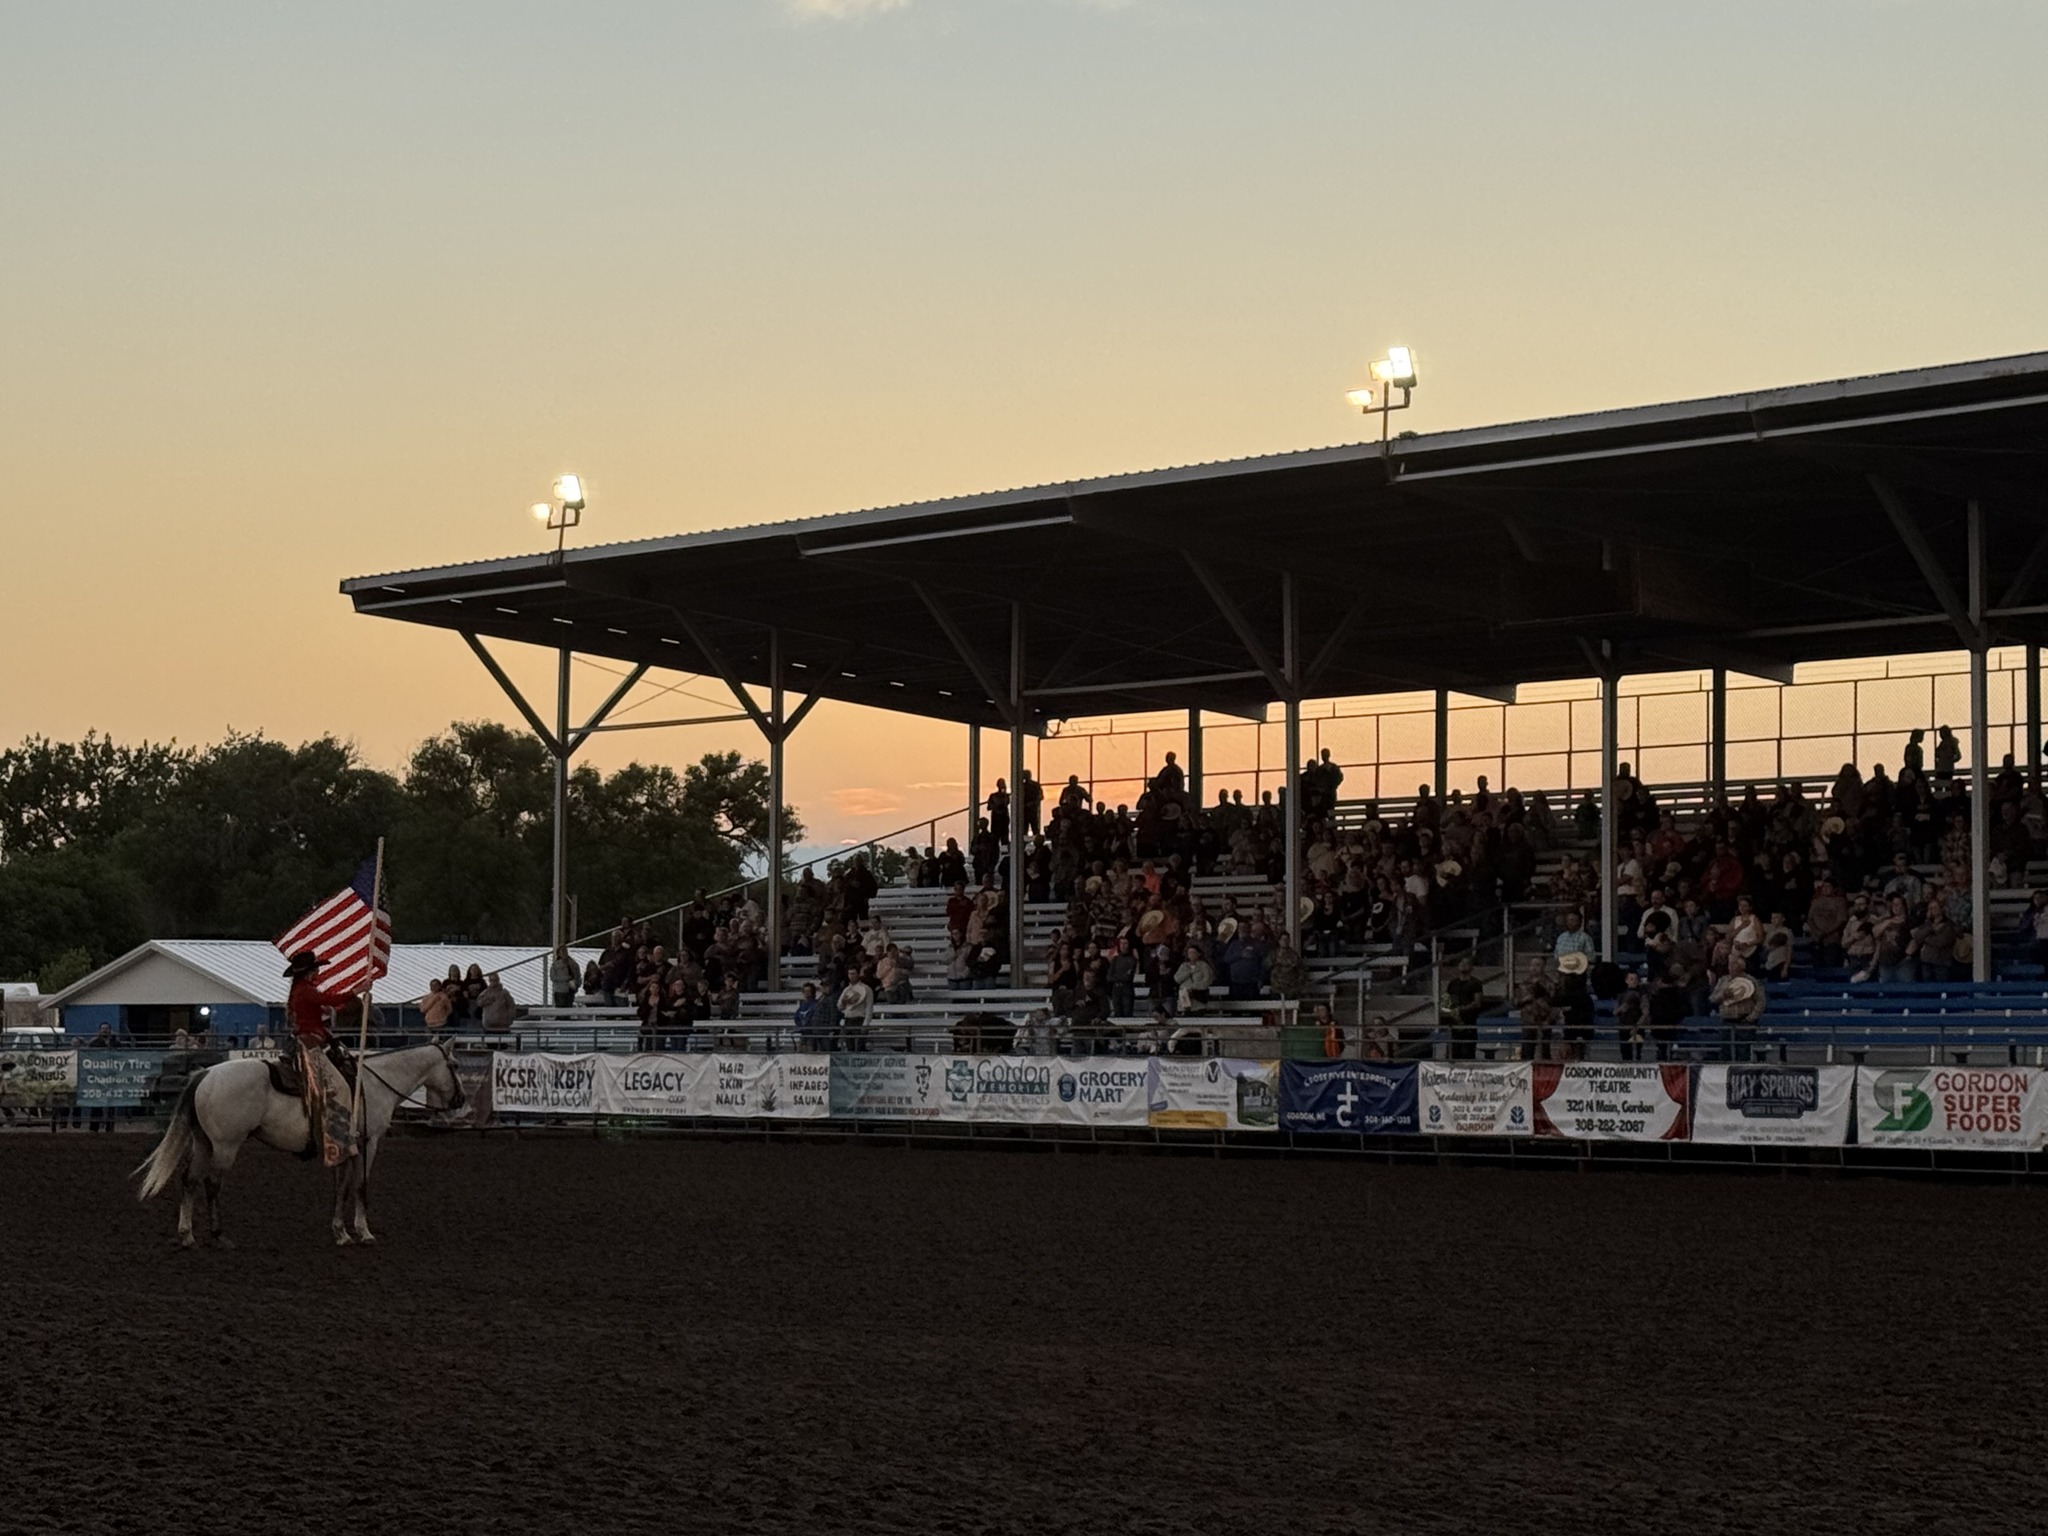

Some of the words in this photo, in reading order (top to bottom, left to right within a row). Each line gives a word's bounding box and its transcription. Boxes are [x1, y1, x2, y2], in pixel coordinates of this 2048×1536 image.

[242, 1051, 266, 1059] LAZY
[82, 1058, 124, 1071] Quality
[128, 1059, 152, 1069] Tire
[719, 1063, 744, 1075] HAIR
[789, 1066, 829, 1076] MASSAGE
[976, 1058, 1051, 1083] Gordon
[495, 1068, 537, 1089] KCSR
[554, 1069, 596, 1090] KBPY
[1079, 1071, 1149, 1087] GROCERY
[1564, 1066, 1603, 1079] GORDON
[1603, 1066, 1660, 1080] COMMUNITY
[624, 1071, 686, 1091] LEGACY
[719, 1078, 744, 1090] SKIN
[978, 1082, 1050, 1094] MEMORIAL
[1589, 1080, 1632, 1094] THEATRE
[1731, 1075, 1757, 1102] HAY
[1760, 1074, 1815, 1103] SPRINGS
[1934, 1072, 2029, 1094] GORDON
[716, 1093, 746, 1106] NAILS
[793, 1095, 825, 1106] SAUNA
[1079, 1088, 1125, 1103] MART
[1566, 1099, 1584, 1112] 320
[1586, 1100, 1594, 1112] N
[1596, 1100, 1621, 1115] Main,
[1622, 1100, 1655, 1114] Gordon
[1943, 1094, 2022, 1113] SUPER
[1946, 1113, 2022, 1133] FOODS
